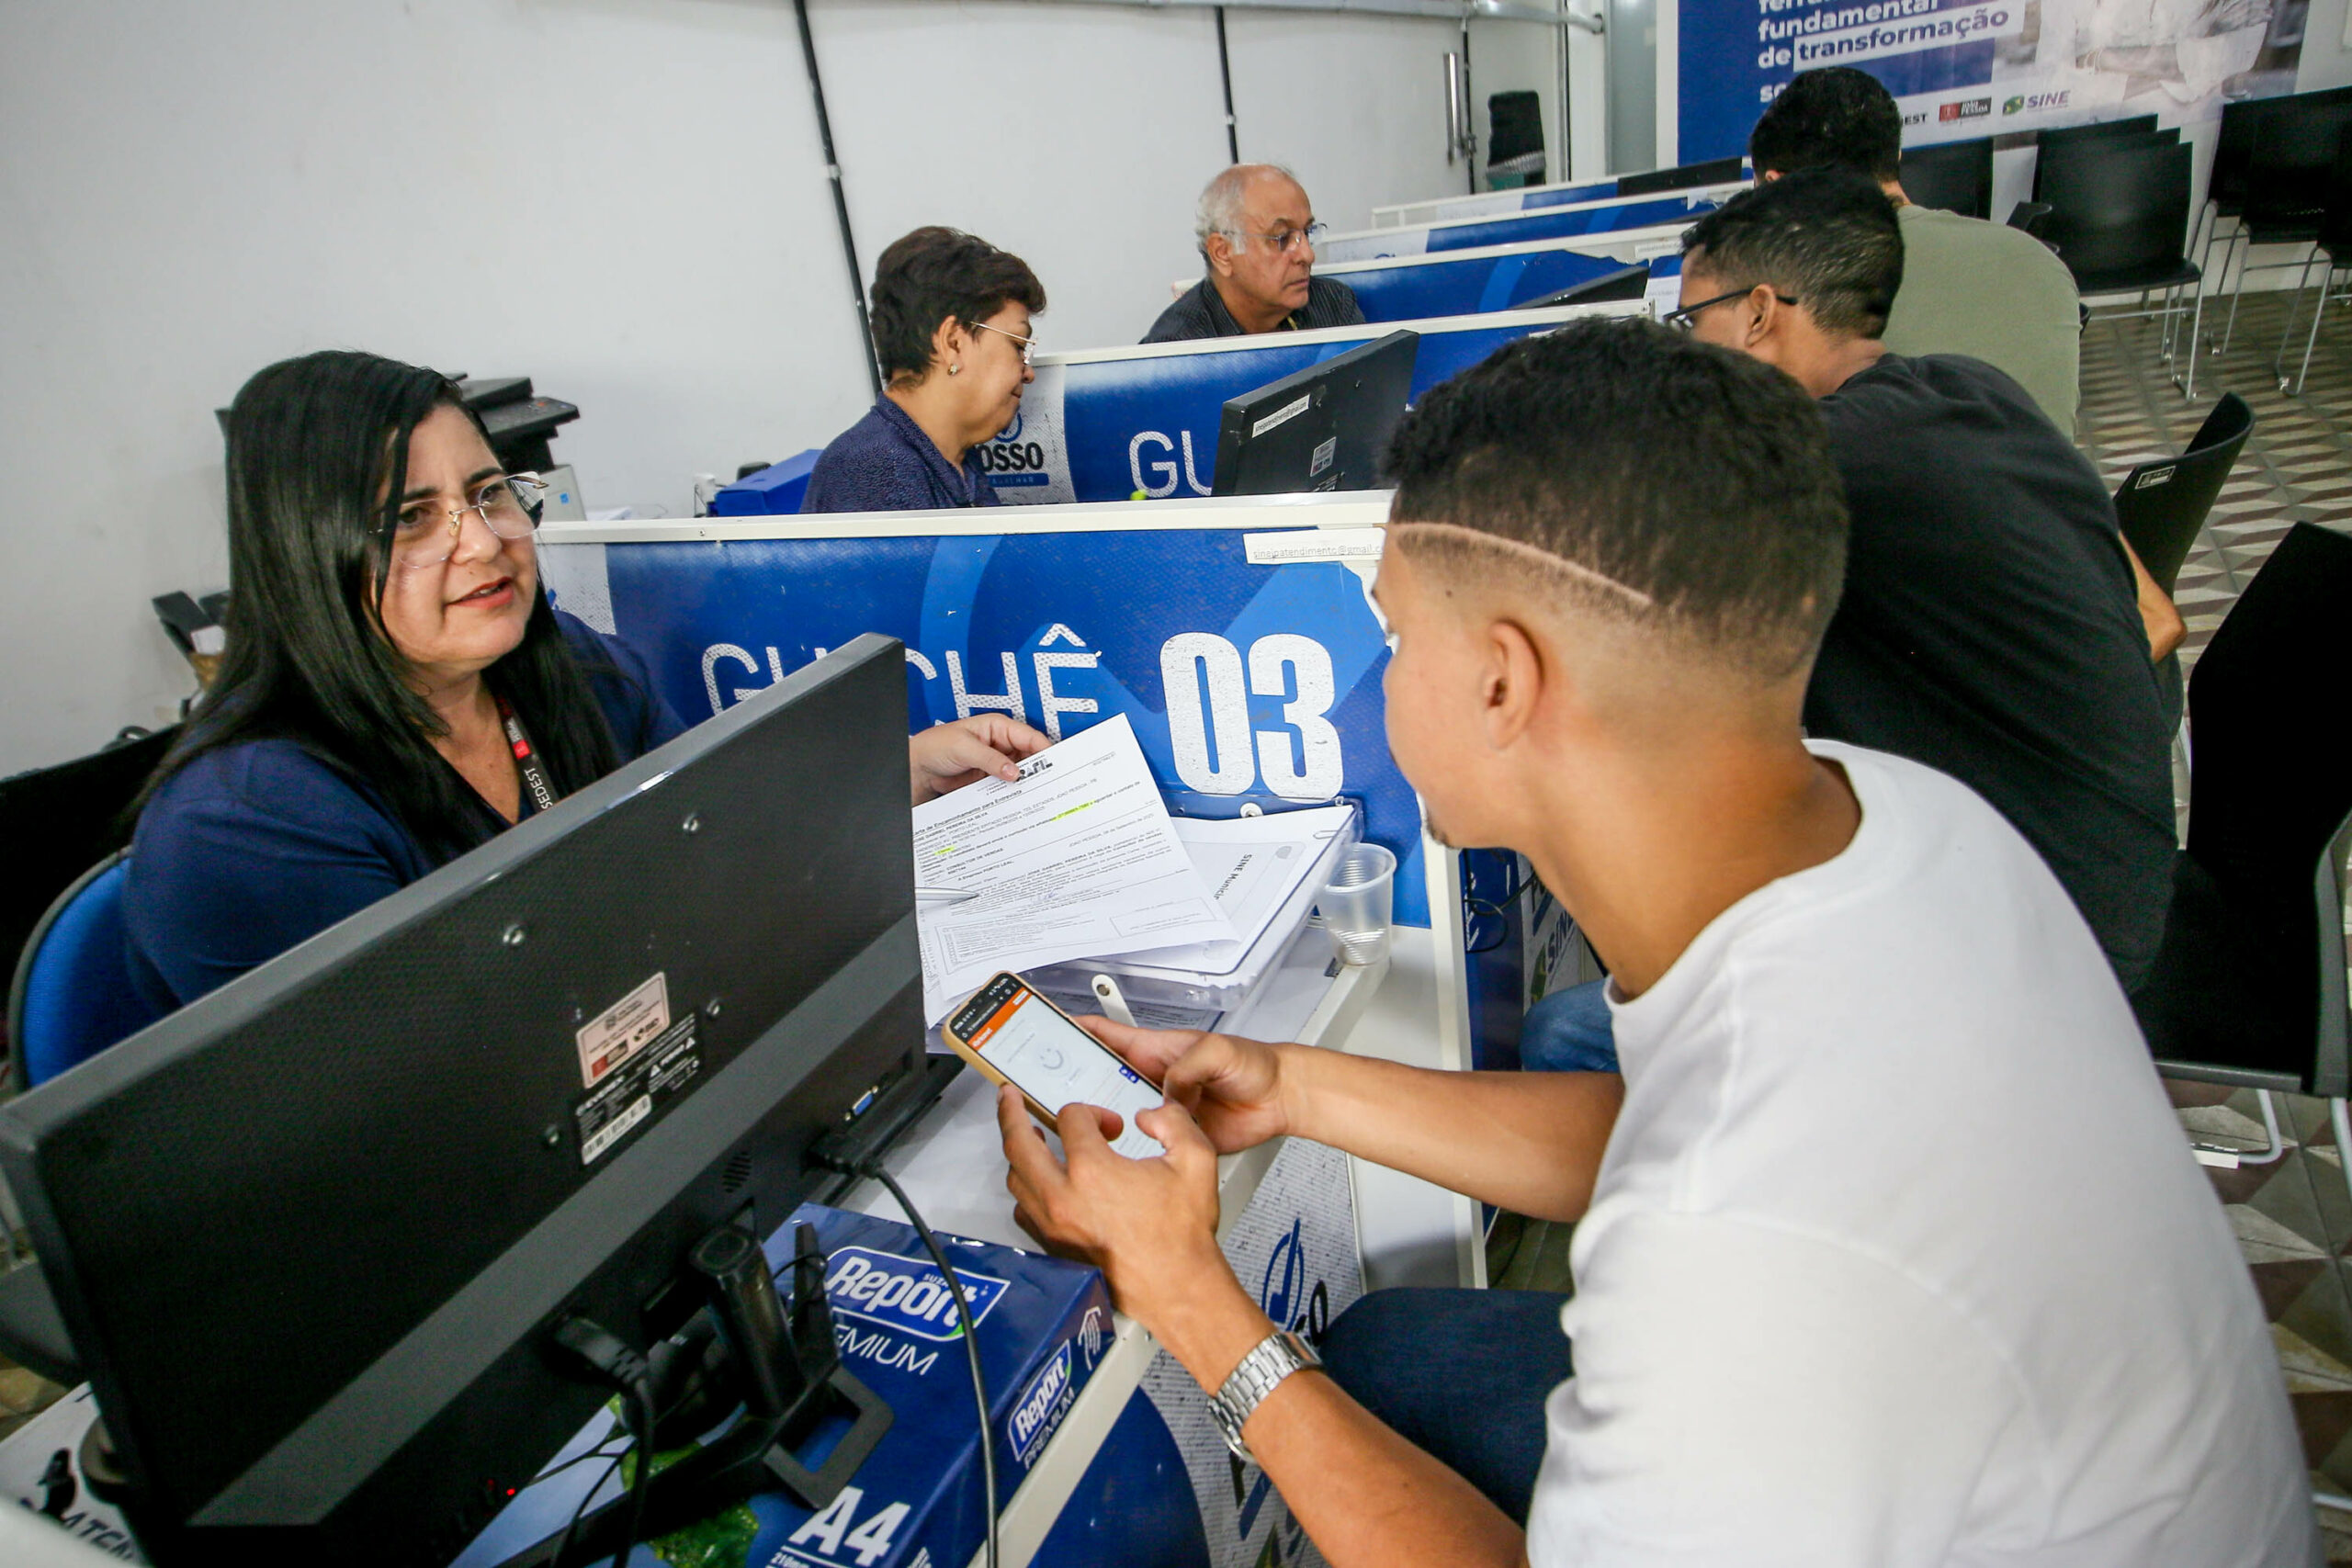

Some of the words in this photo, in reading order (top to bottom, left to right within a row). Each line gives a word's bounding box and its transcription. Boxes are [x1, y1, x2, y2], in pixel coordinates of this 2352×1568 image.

[1758, 46, 1791, 69] de
[1798, 8, 2009, 61] transformação
[2027, 91, 2069, 109] SINE
[1159, 631, 1344, 800] 03
[524, 767, 553, 809] SEDEST
[825, 1256, 978, 1327] Report
[1014, 1356, 1066, 1442] Report
[1023, 1385, 1075, 1470] PREMIUM
[787, 1485, 911, 1567] A4
